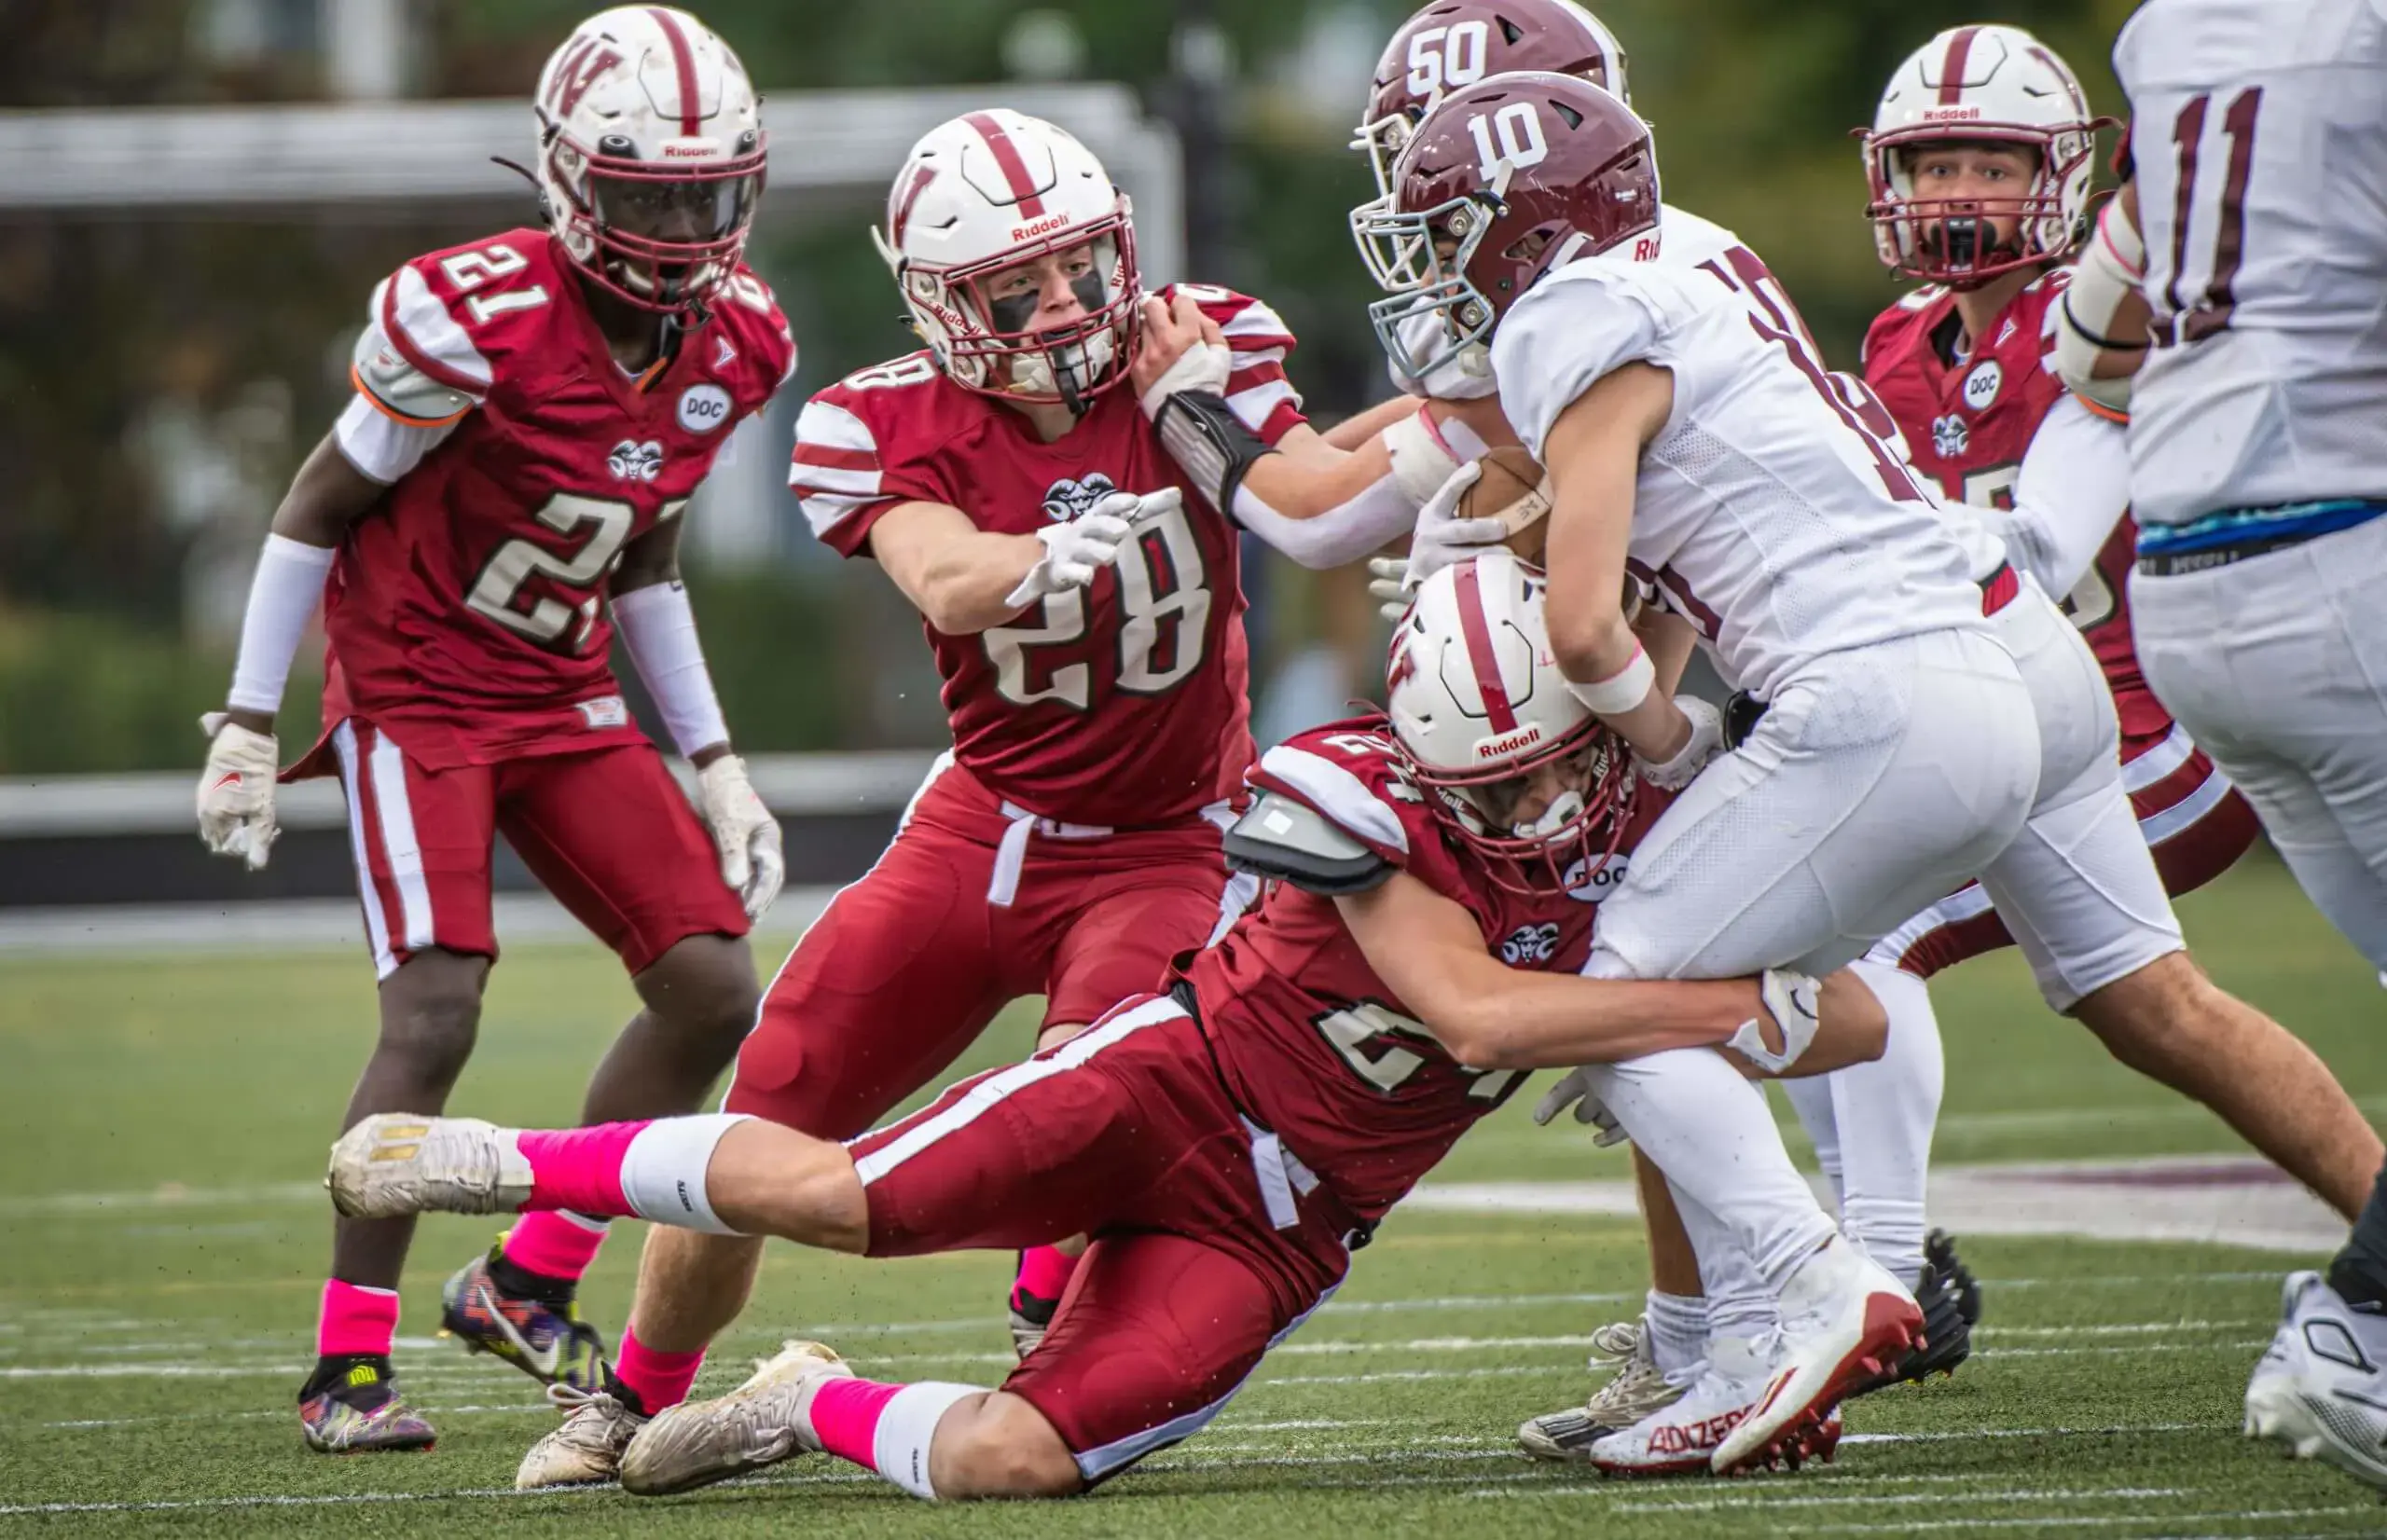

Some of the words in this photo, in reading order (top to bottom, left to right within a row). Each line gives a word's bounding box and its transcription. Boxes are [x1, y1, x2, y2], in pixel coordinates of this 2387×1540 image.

[546, 34, 624, 118] W
[1406, 21, 1488, 96] 50
[1468, 102, 1548, 183] 10
[1924, 108, 1980, 120] Riddell
[1013, 213, 1070, 241] Riddell
[2146, 86, 2264, 348] 11
[441, 245, 552, 325] 21
[686, 396, 723, 419] DOC
[1970, 374, 1997, 395] DOC
[981, 503, 1212, 713] 28
[1479, 729, 1540, 758] Riddell
